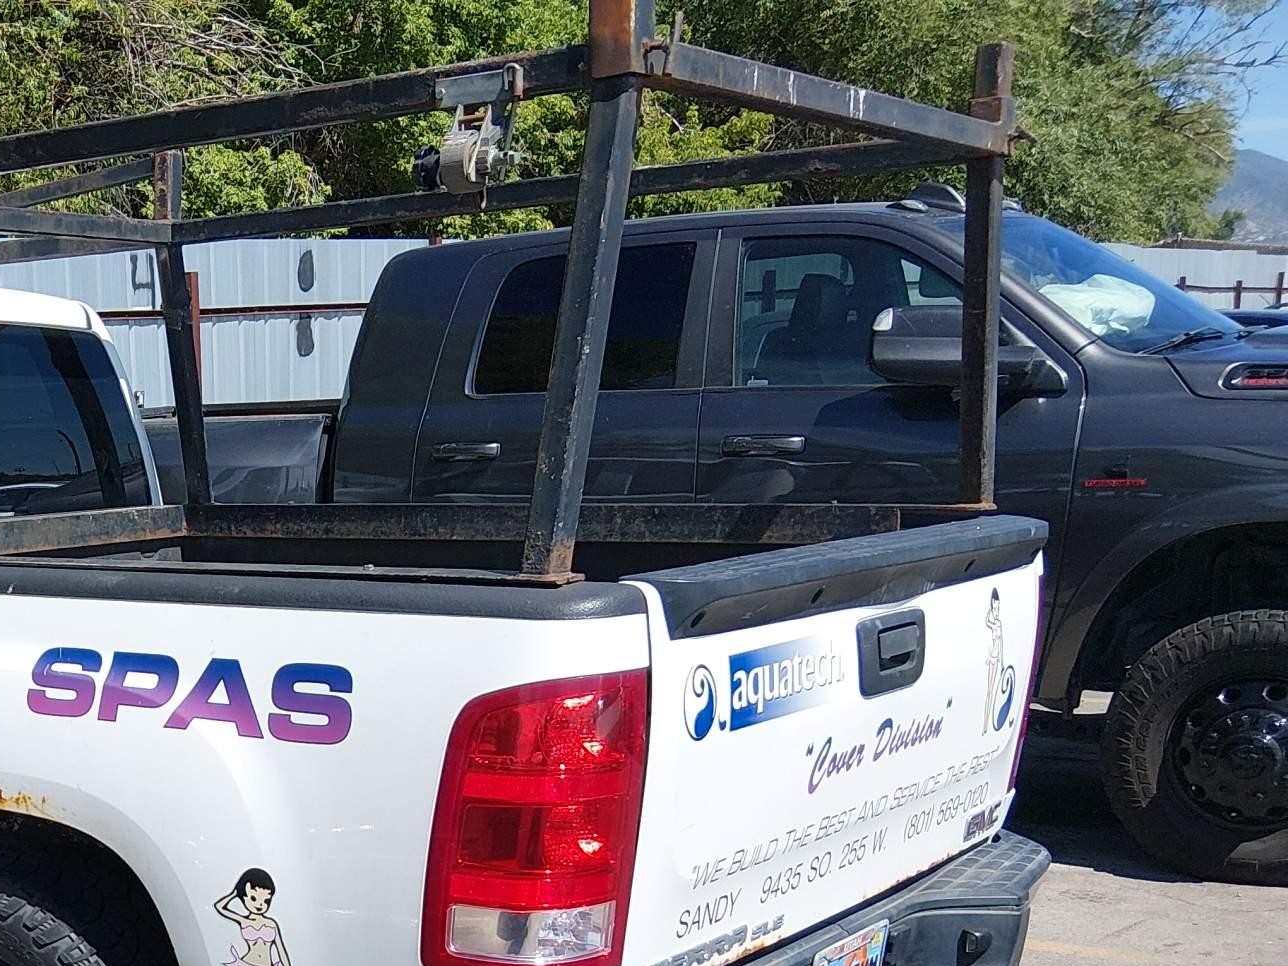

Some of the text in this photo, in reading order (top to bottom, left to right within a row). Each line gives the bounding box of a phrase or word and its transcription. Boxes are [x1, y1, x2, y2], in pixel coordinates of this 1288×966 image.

[27, 647, 353, 745] SPAS
[732, 640, 845, 716] aquatech
[676, 782, 990, 938] SANDY 9435 SO. 255 W. (801) 569-0120
[727, 838, 779, 876] BUILD
[782, 823, 815, 854] THE
[814, 807, 857, 842] BEST
[854, 795, 889, 824] AND
[889, 772, 943, 810] SERVICE
